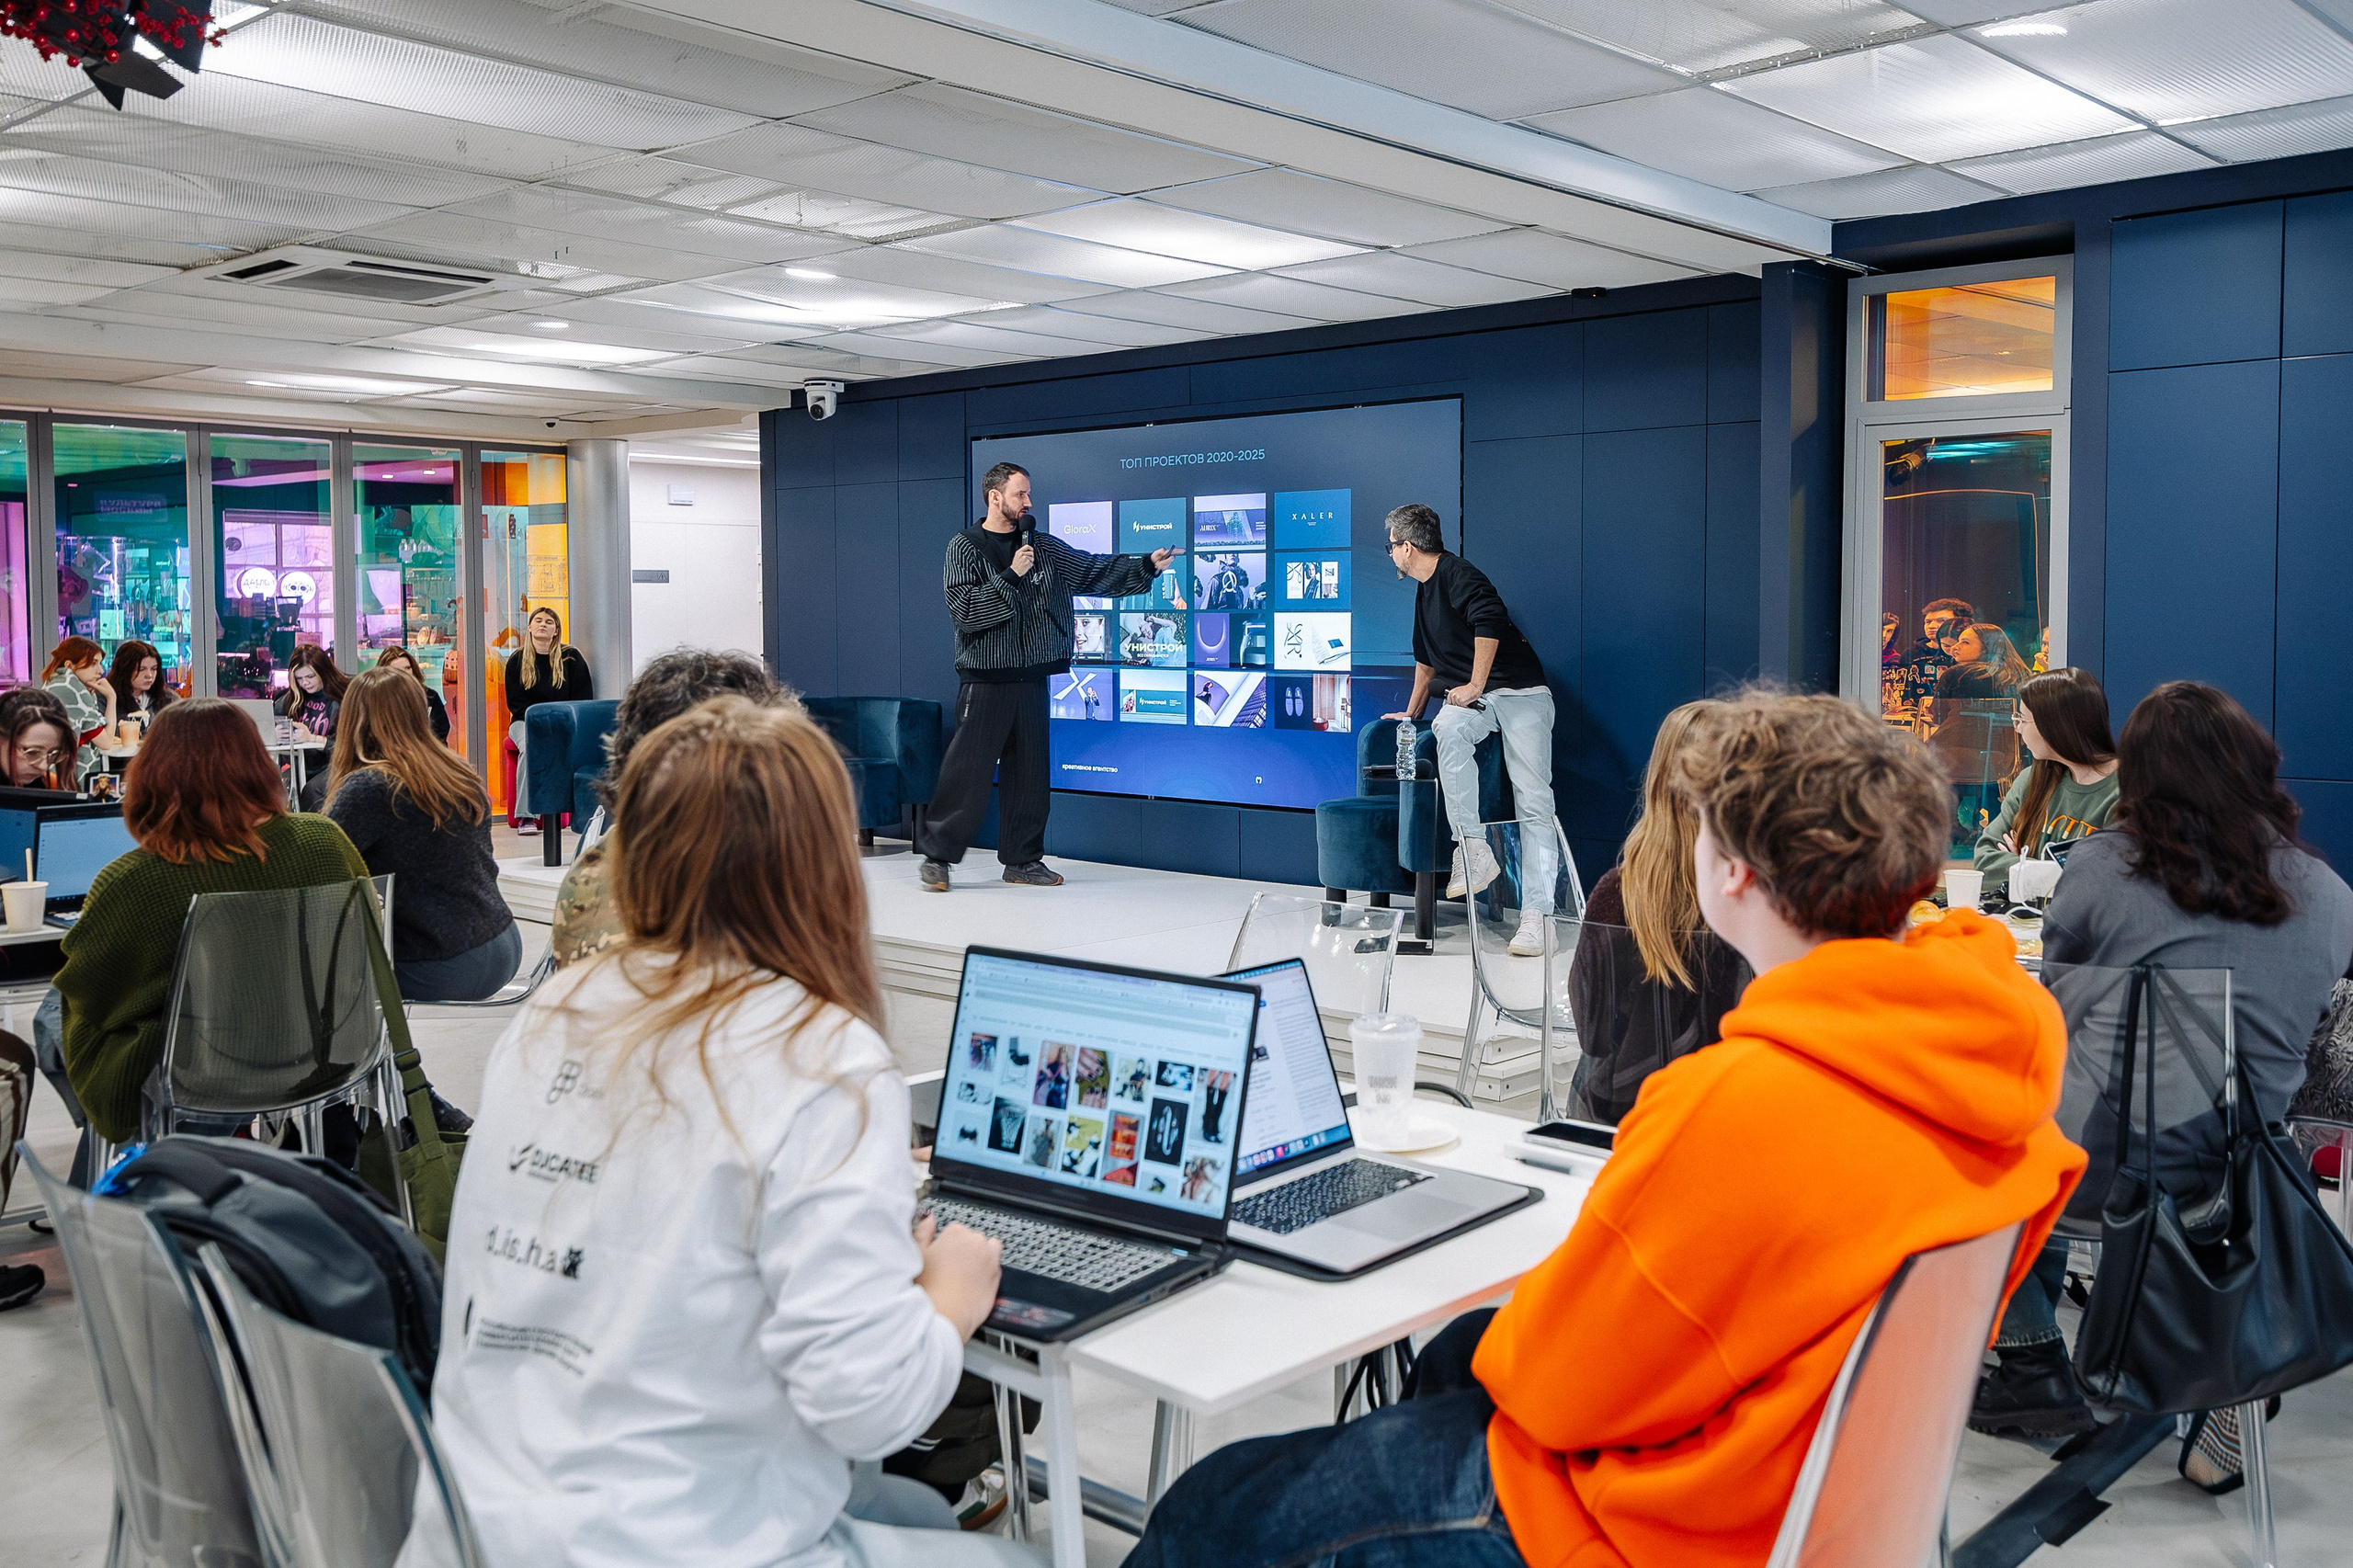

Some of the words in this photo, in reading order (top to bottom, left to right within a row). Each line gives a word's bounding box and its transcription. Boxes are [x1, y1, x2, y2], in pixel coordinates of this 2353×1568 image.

[1120, 458, 1142, 469] ТОП
[1144, 453, 1205, 467] ПРОЕКТОВ
[1206, 449, 1266, 463] 2020-2025
[1291, 511, 1334, 520] XALER
[1063, 523, 1097, 534] GloraX
[1140, 522, 1173, 530] УНИСТРОЙ
[1125, 641, 1184, 653] УНИСТРОЙ
